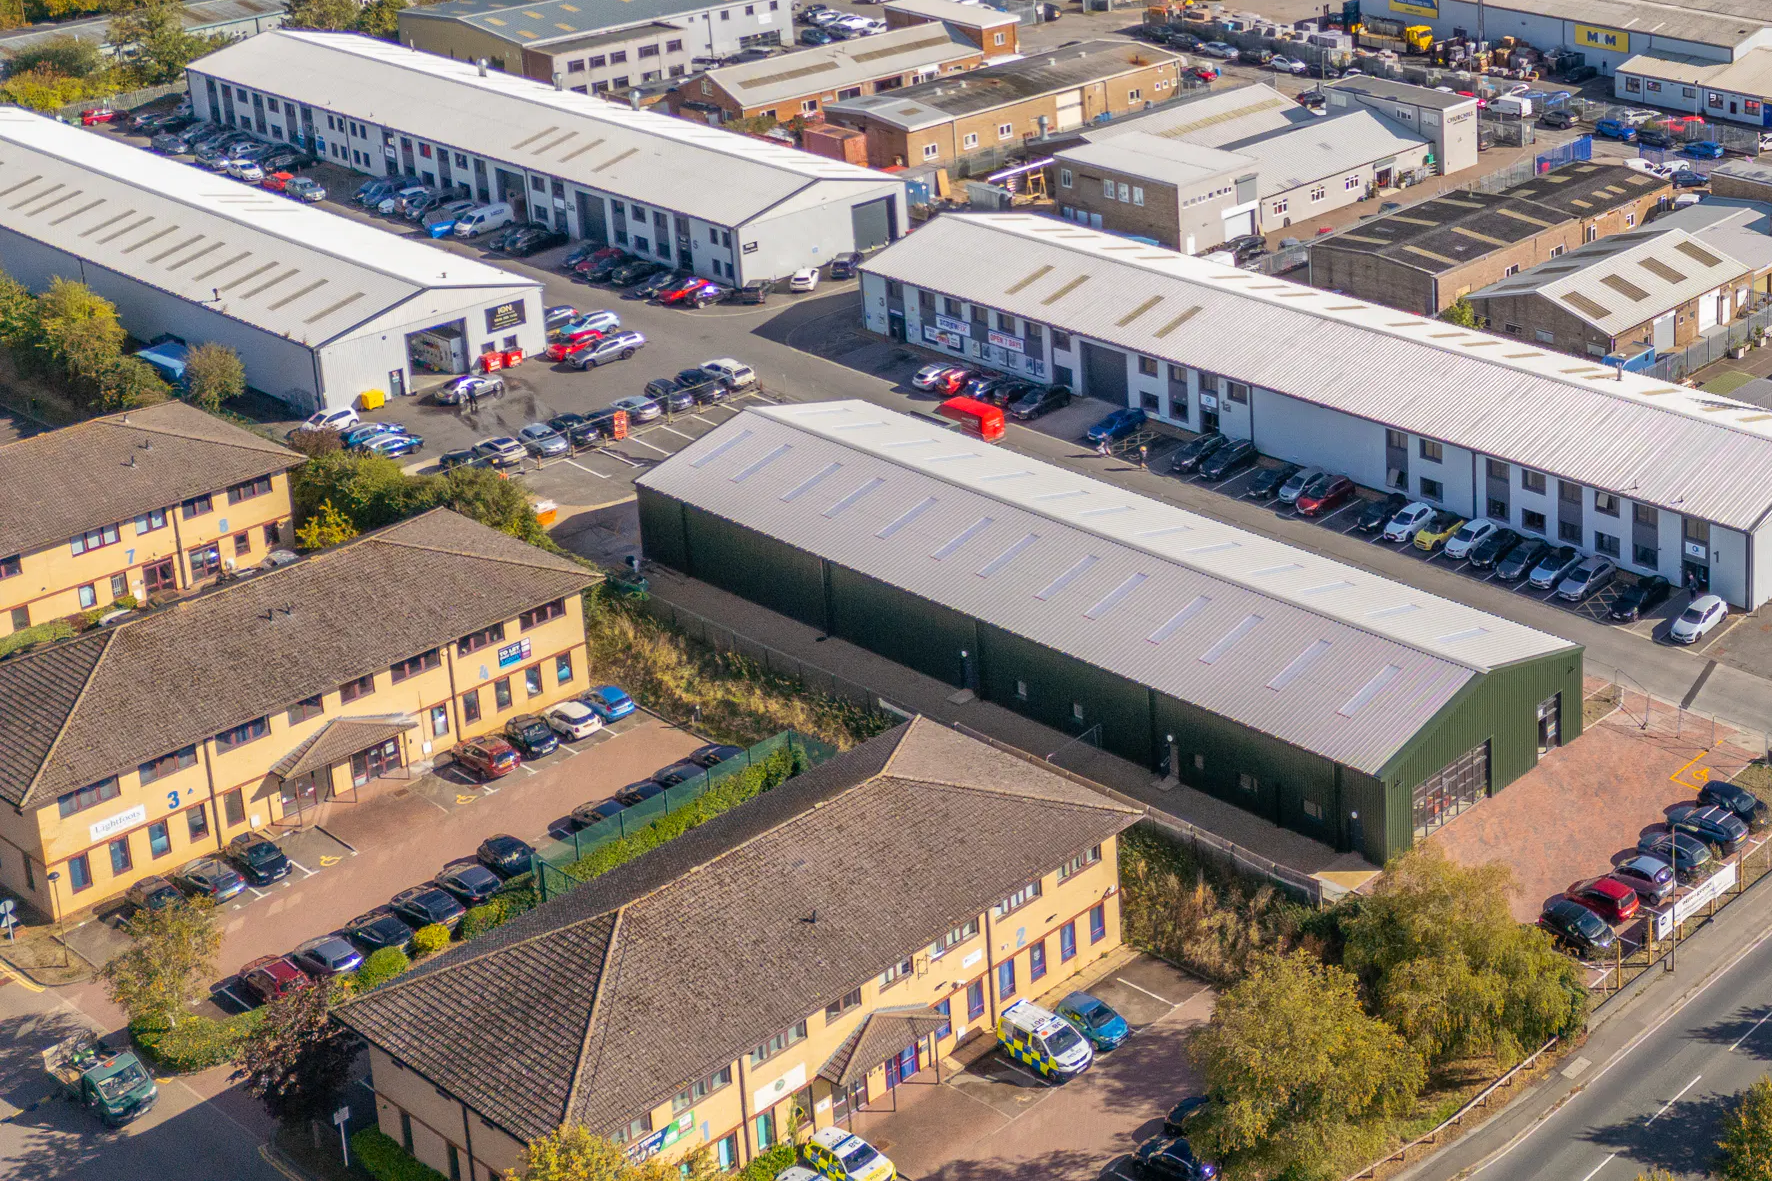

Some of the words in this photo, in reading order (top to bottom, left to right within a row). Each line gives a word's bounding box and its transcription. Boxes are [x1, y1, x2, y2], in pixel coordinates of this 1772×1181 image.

[125, 548, 135, 564] 7
[1713, 550, 1719, 563] 1
[167, 790, 180, 809] 3
[95, 810, 141, 834] Lightfoots
[1016, 926, 1026, 948] 2
